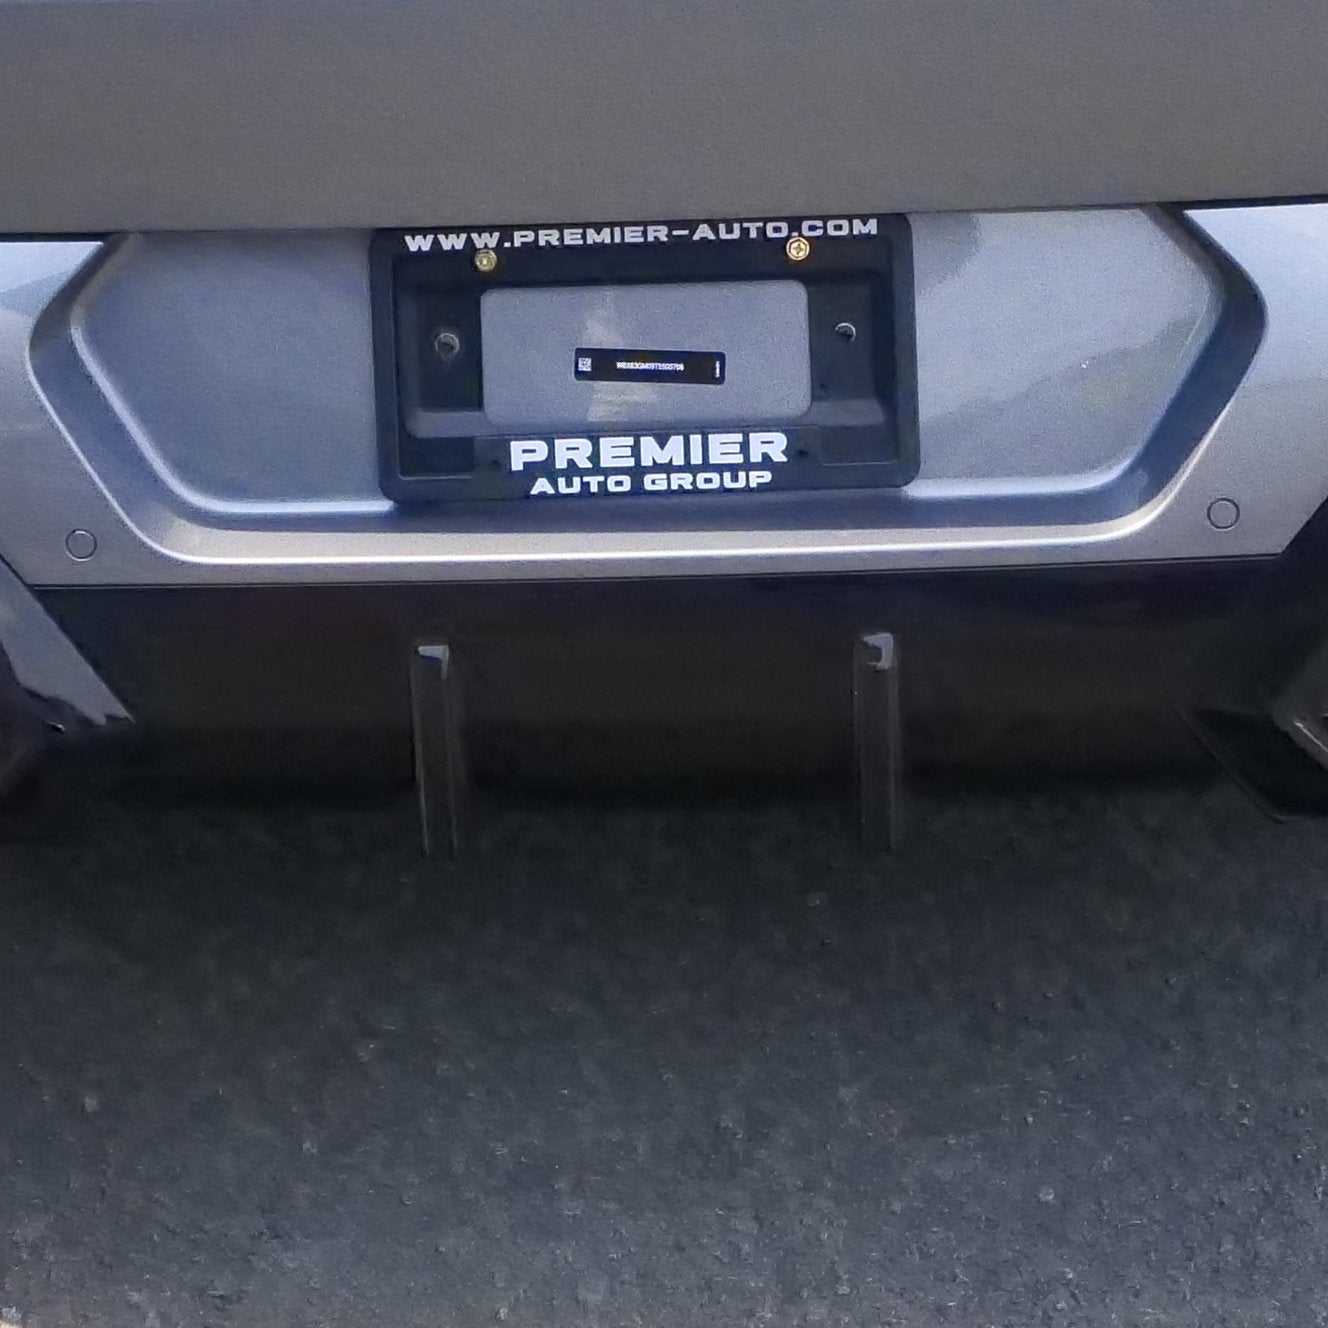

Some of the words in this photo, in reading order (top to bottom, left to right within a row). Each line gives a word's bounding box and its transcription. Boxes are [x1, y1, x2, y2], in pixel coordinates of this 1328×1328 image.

[404, 218, 879, 252] WWW.PREMIER-AUTO.COM
[509, 431, 789, 471] PREMIER
[529, 474, 631, 495] AUTO
[643, 471, 773, 492] GROUP
